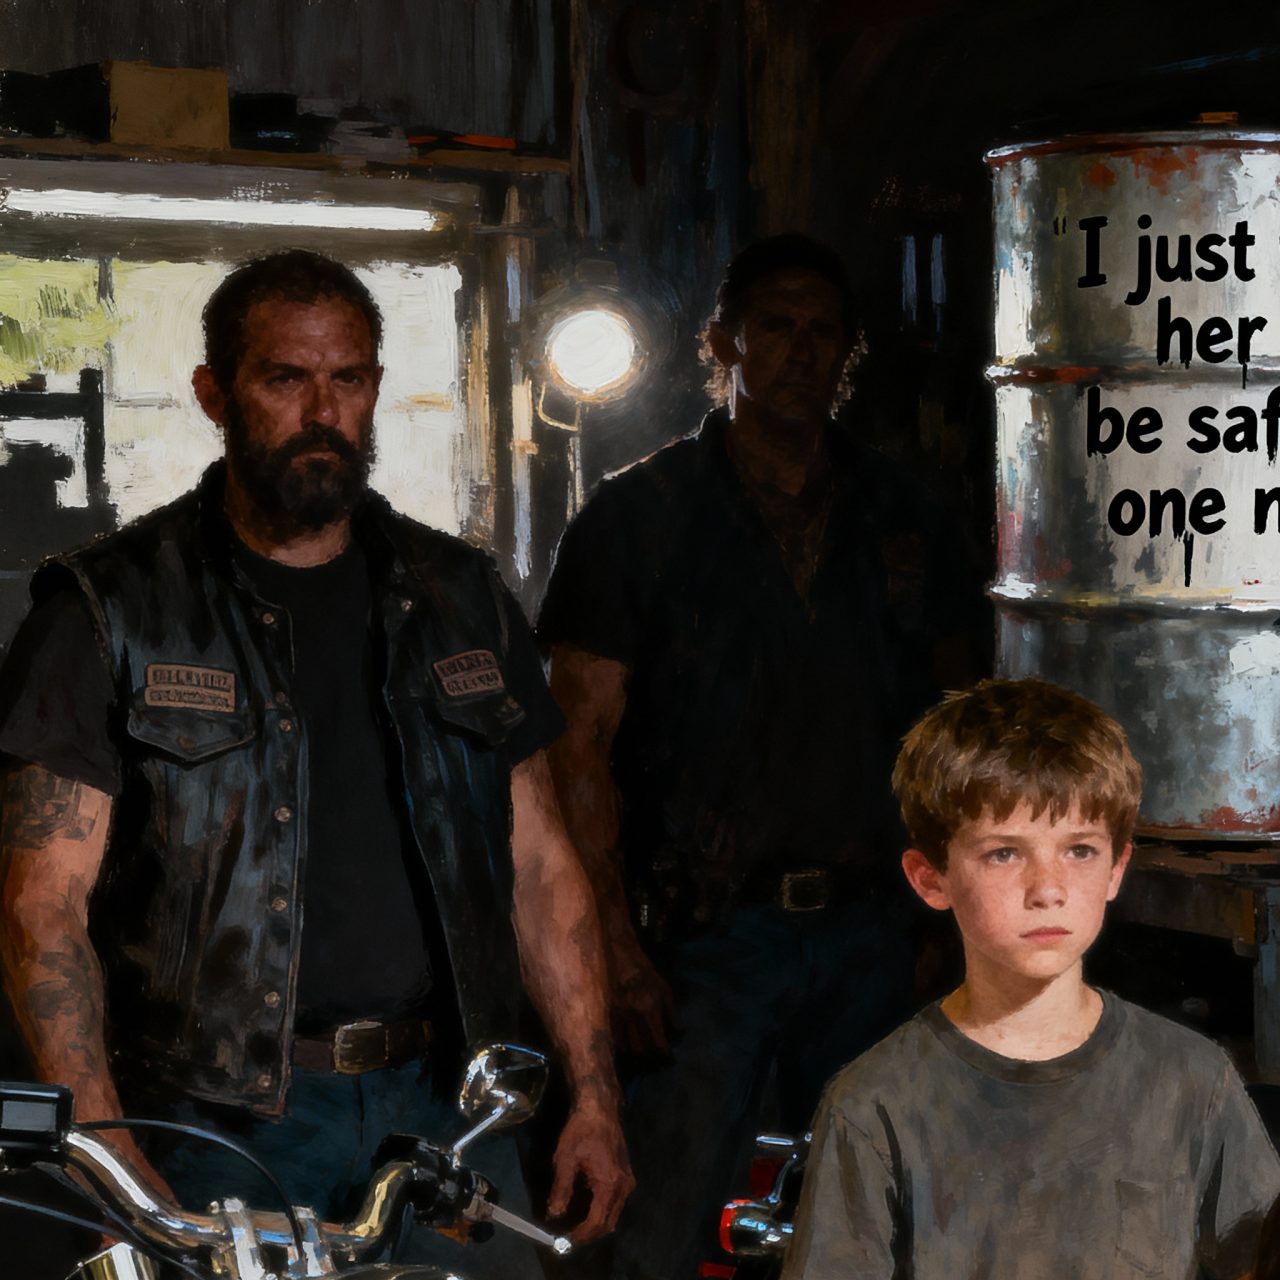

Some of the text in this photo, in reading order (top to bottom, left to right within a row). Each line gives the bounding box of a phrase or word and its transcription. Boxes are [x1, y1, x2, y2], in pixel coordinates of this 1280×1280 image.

[1124, 213, 1256, 306] just
[1156, 296, 1268, 369] her
[1086, 386, 1164, 458] be
[1107, 486, 1226, 538] one
